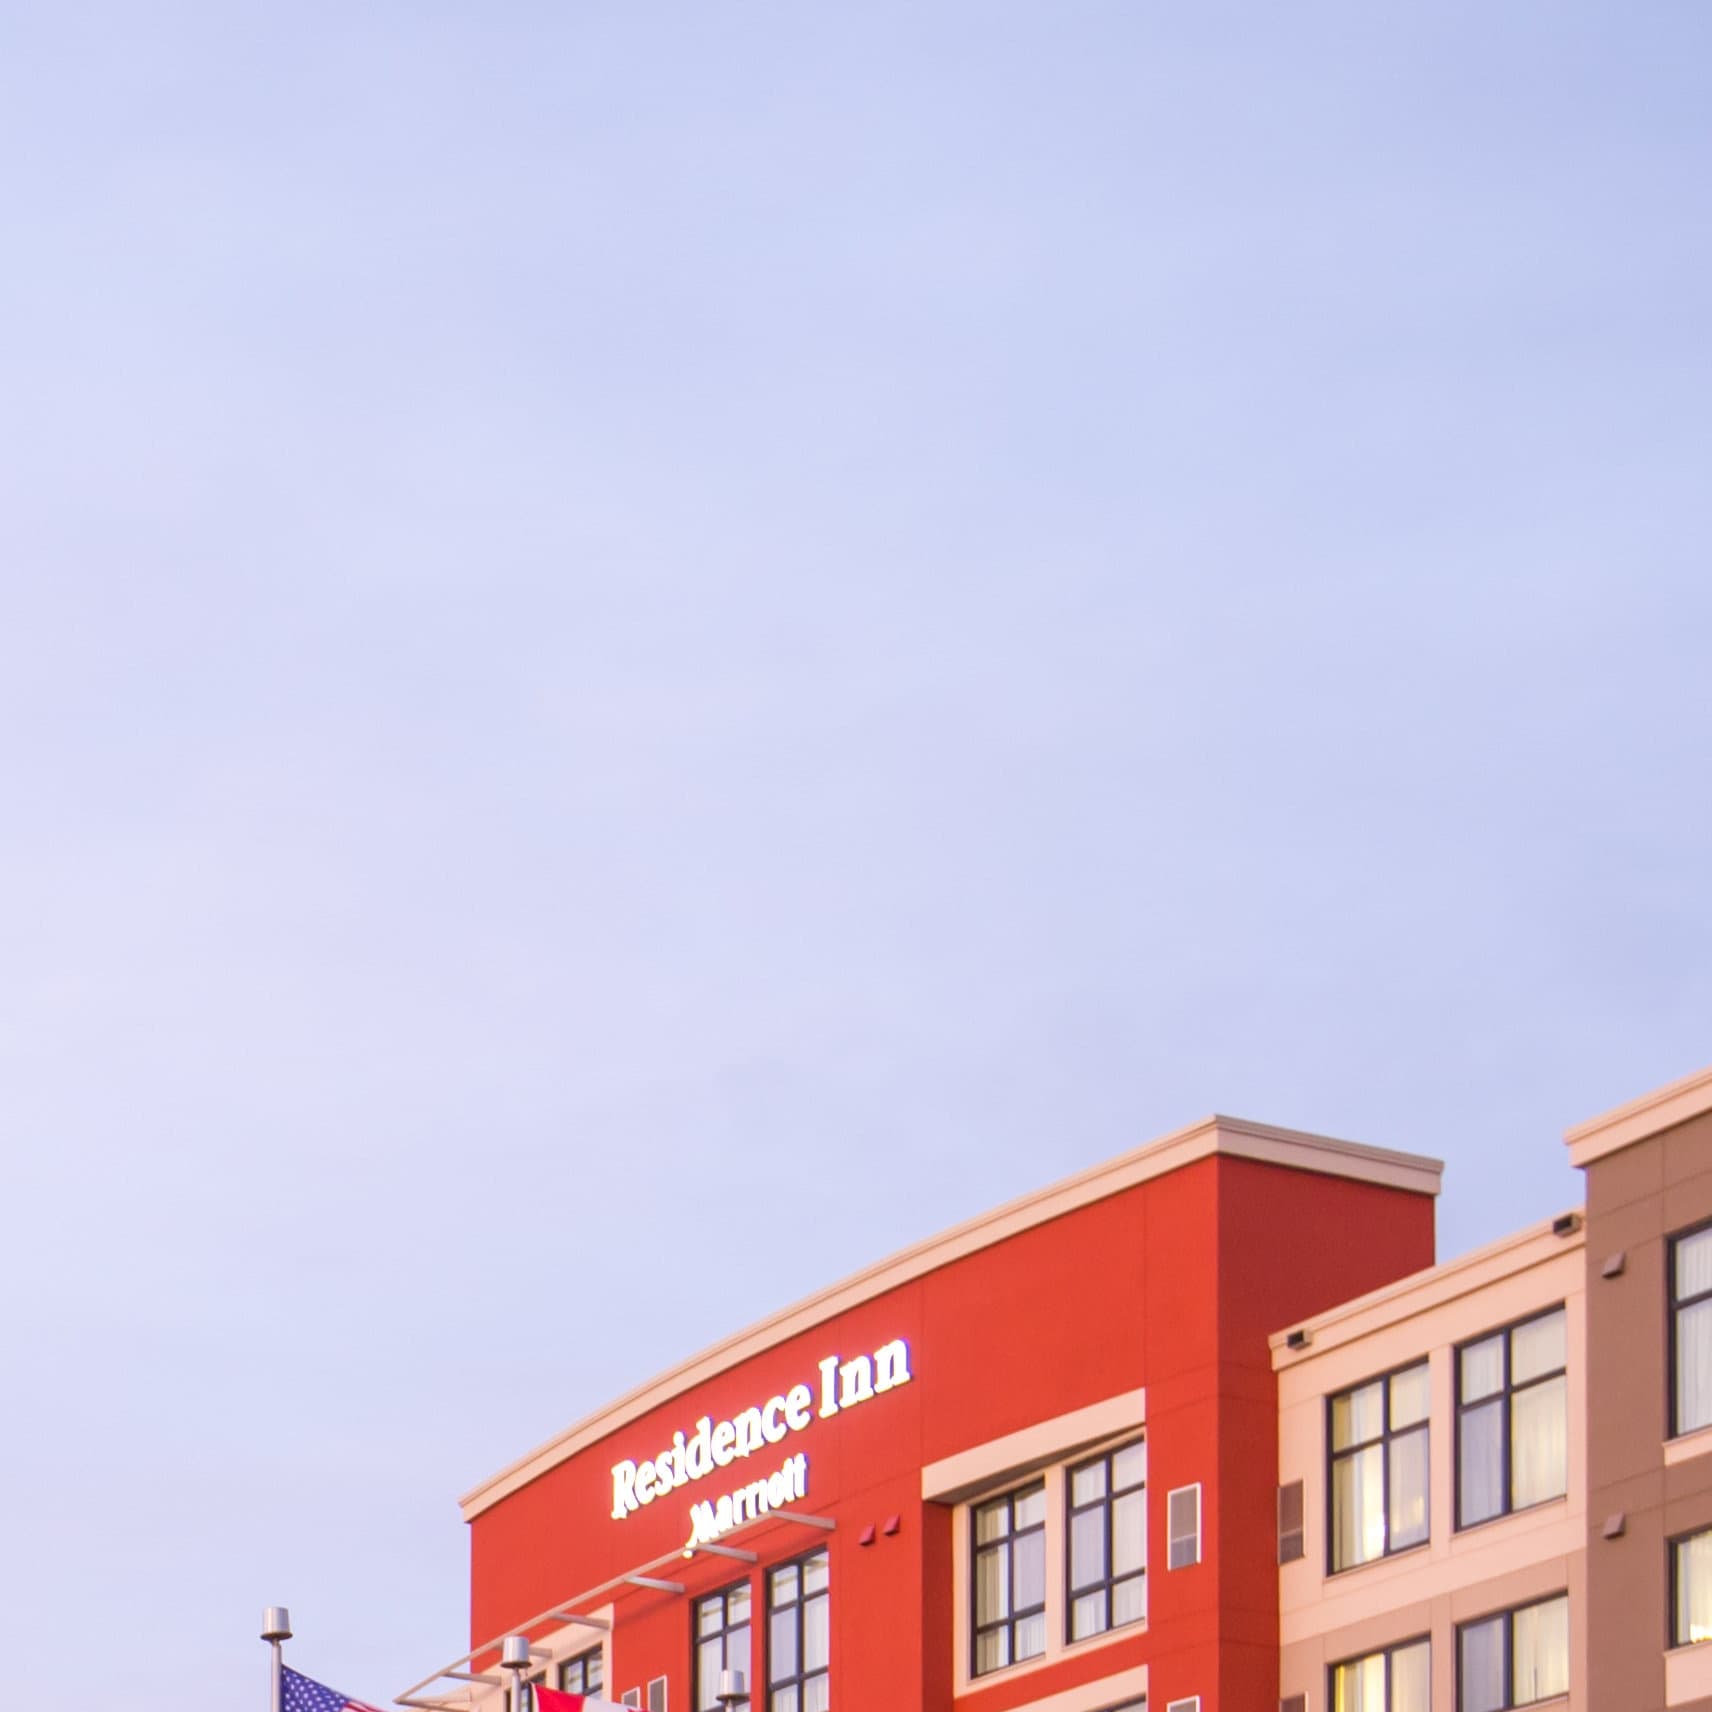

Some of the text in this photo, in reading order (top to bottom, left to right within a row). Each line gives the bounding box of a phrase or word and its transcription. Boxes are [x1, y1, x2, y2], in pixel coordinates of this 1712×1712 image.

[611, 1337, 911, 1520] Residence Inn
[682, 1452, 808, 1559] Marriott
